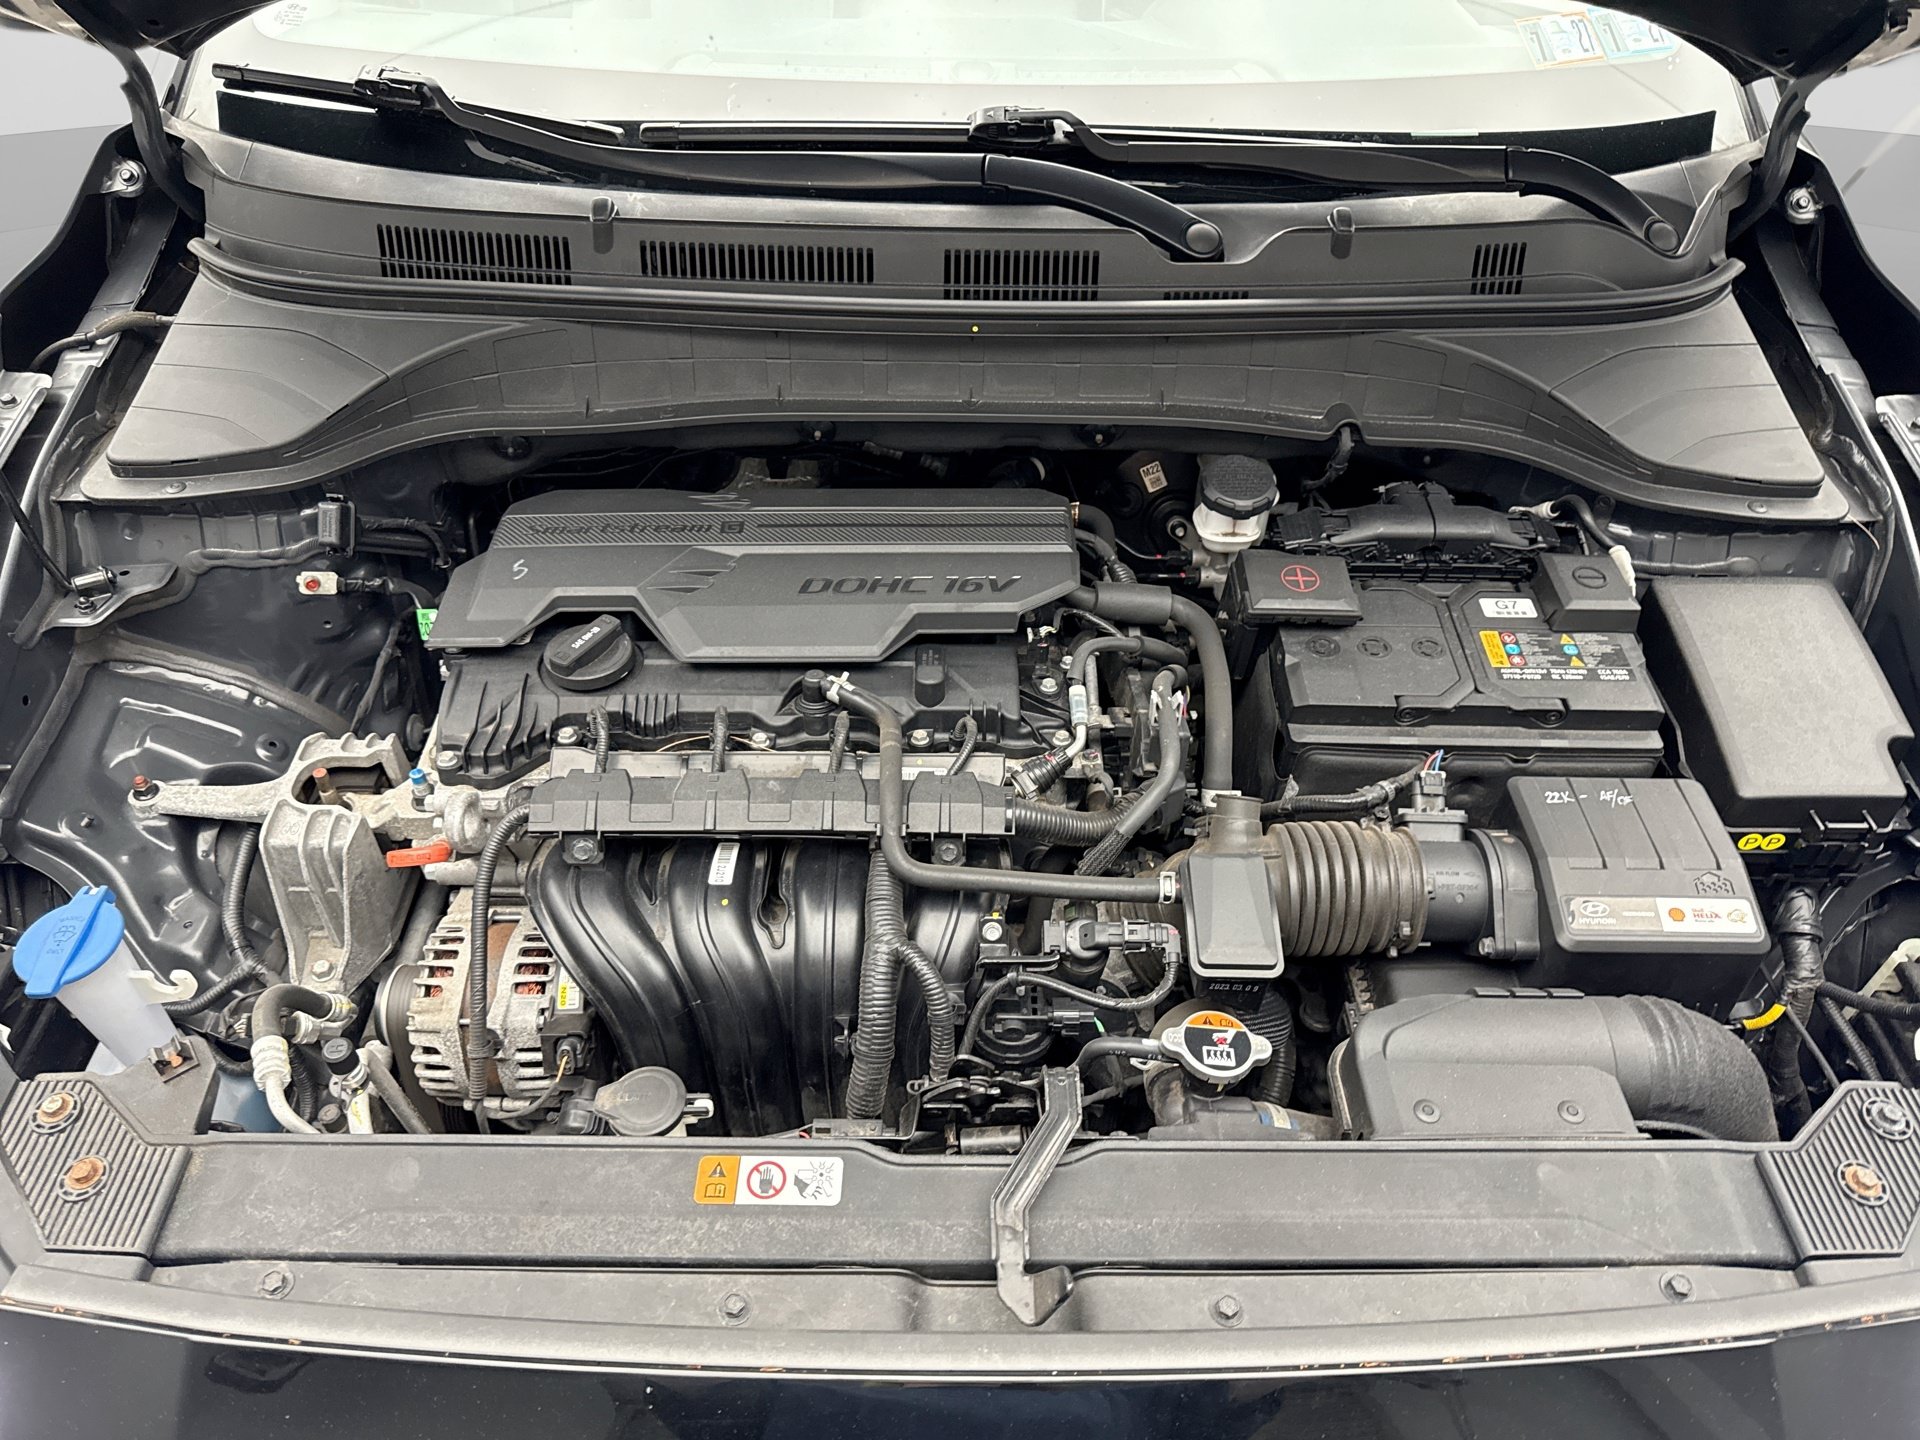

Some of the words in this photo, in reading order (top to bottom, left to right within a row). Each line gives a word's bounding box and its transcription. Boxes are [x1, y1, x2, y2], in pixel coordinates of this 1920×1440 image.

[523, 522, 712, 535] Smartstream
[798, 575, 934, 594] DOHC
[943, 575, 1022, 594] 16V
[1495, 600, 1518, 610] G7
[1693, 912, 1722, 920] HELIX
[1579, 918, 1617, 926] HYUNDAI
